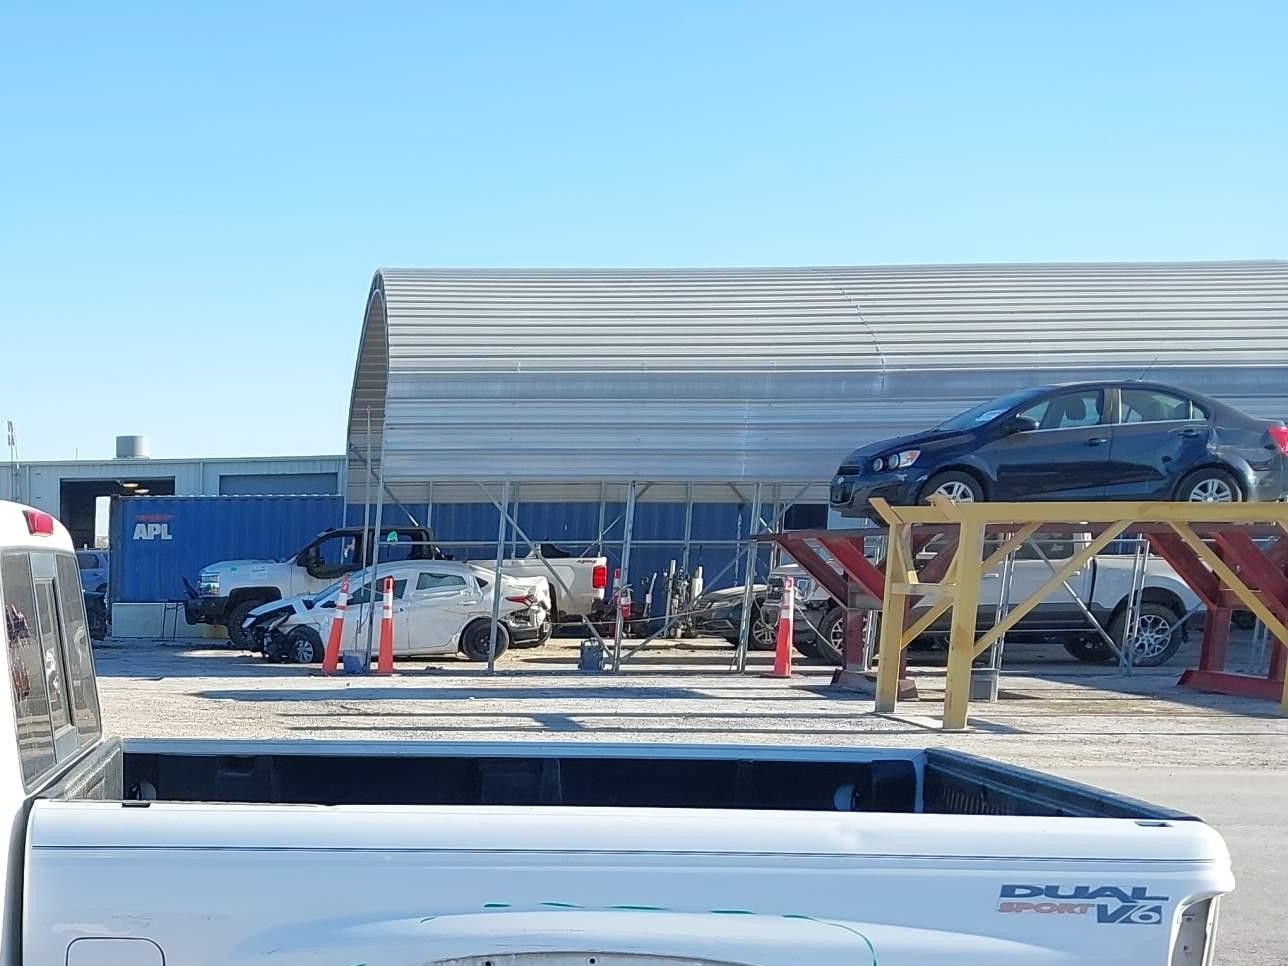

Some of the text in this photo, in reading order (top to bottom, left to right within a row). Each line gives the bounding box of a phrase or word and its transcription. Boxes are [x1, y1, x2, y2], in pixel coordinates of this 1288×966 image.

[133, 523, 173, 540] APL
[999, 884, 1170, 903] DUAL
[998, 902, 1163, 925] SPORT V6
